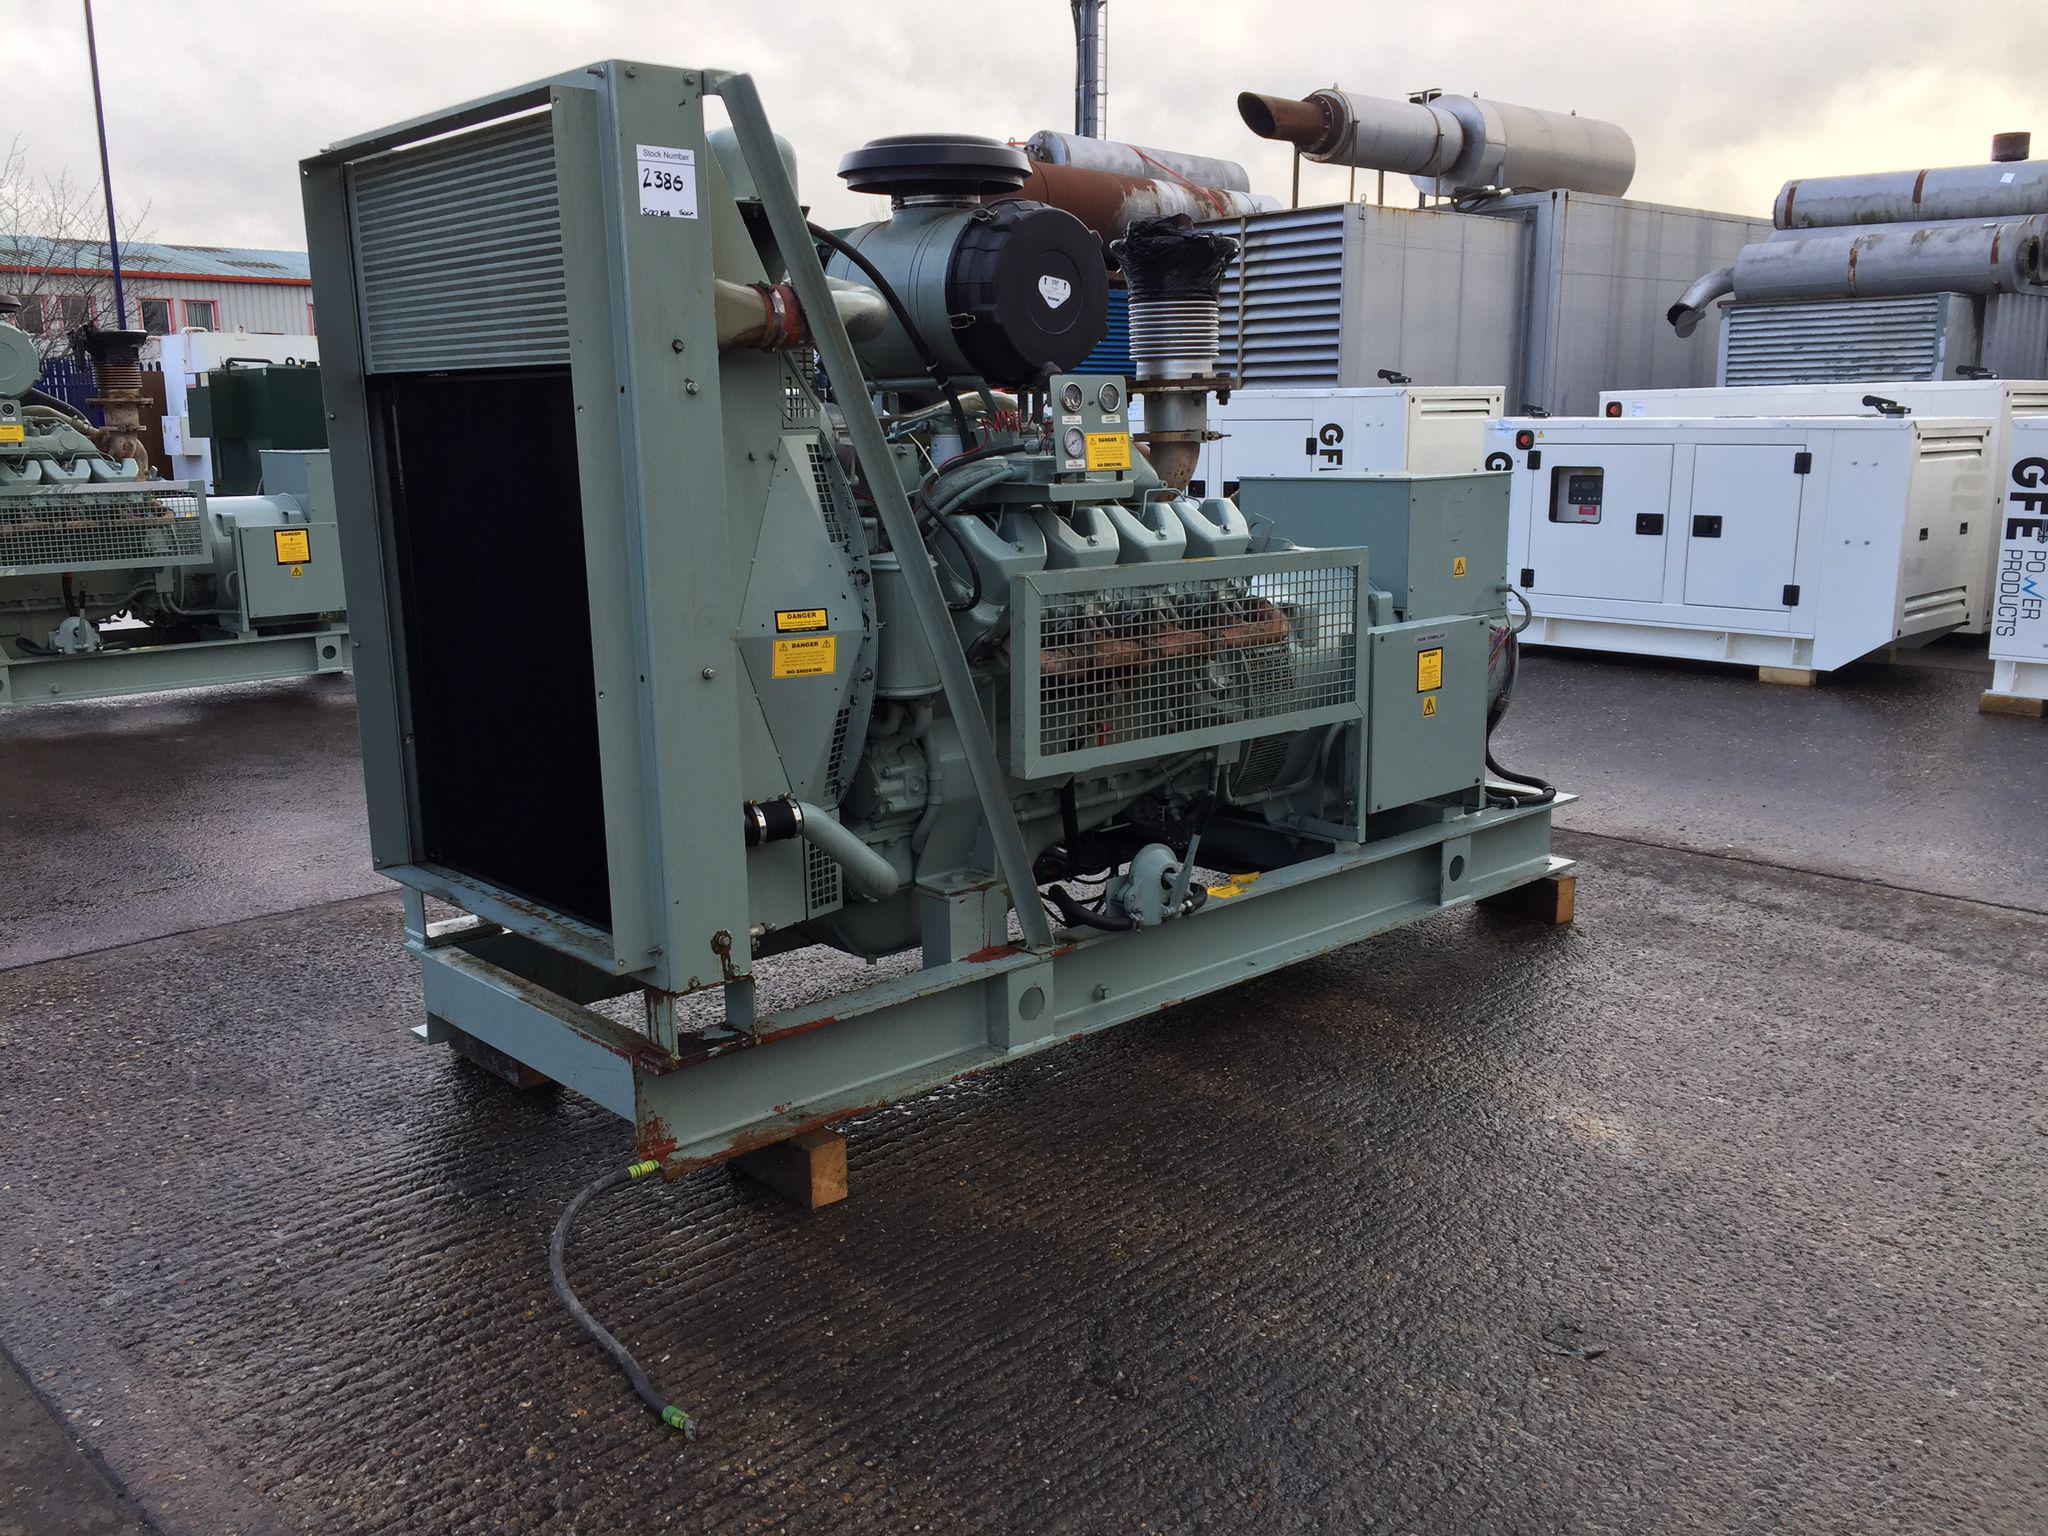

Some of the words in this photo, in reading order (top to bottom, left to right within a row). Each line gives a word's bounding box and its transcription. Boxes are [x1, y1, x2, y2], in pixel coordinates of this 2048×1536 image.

[642, 149, 662, 159] Stock
[663, 151, 690, 161] Number
[643, 168, 684, 192] 2386
[1319, 423, 1344, 471] GF
[1996, 548, 2024, 637] PRODUCTS
[2021, 549, 2048, 620] POWER
[786, 611, 817, 620] DANGER
[791, 641, 819, 649] DANGER
